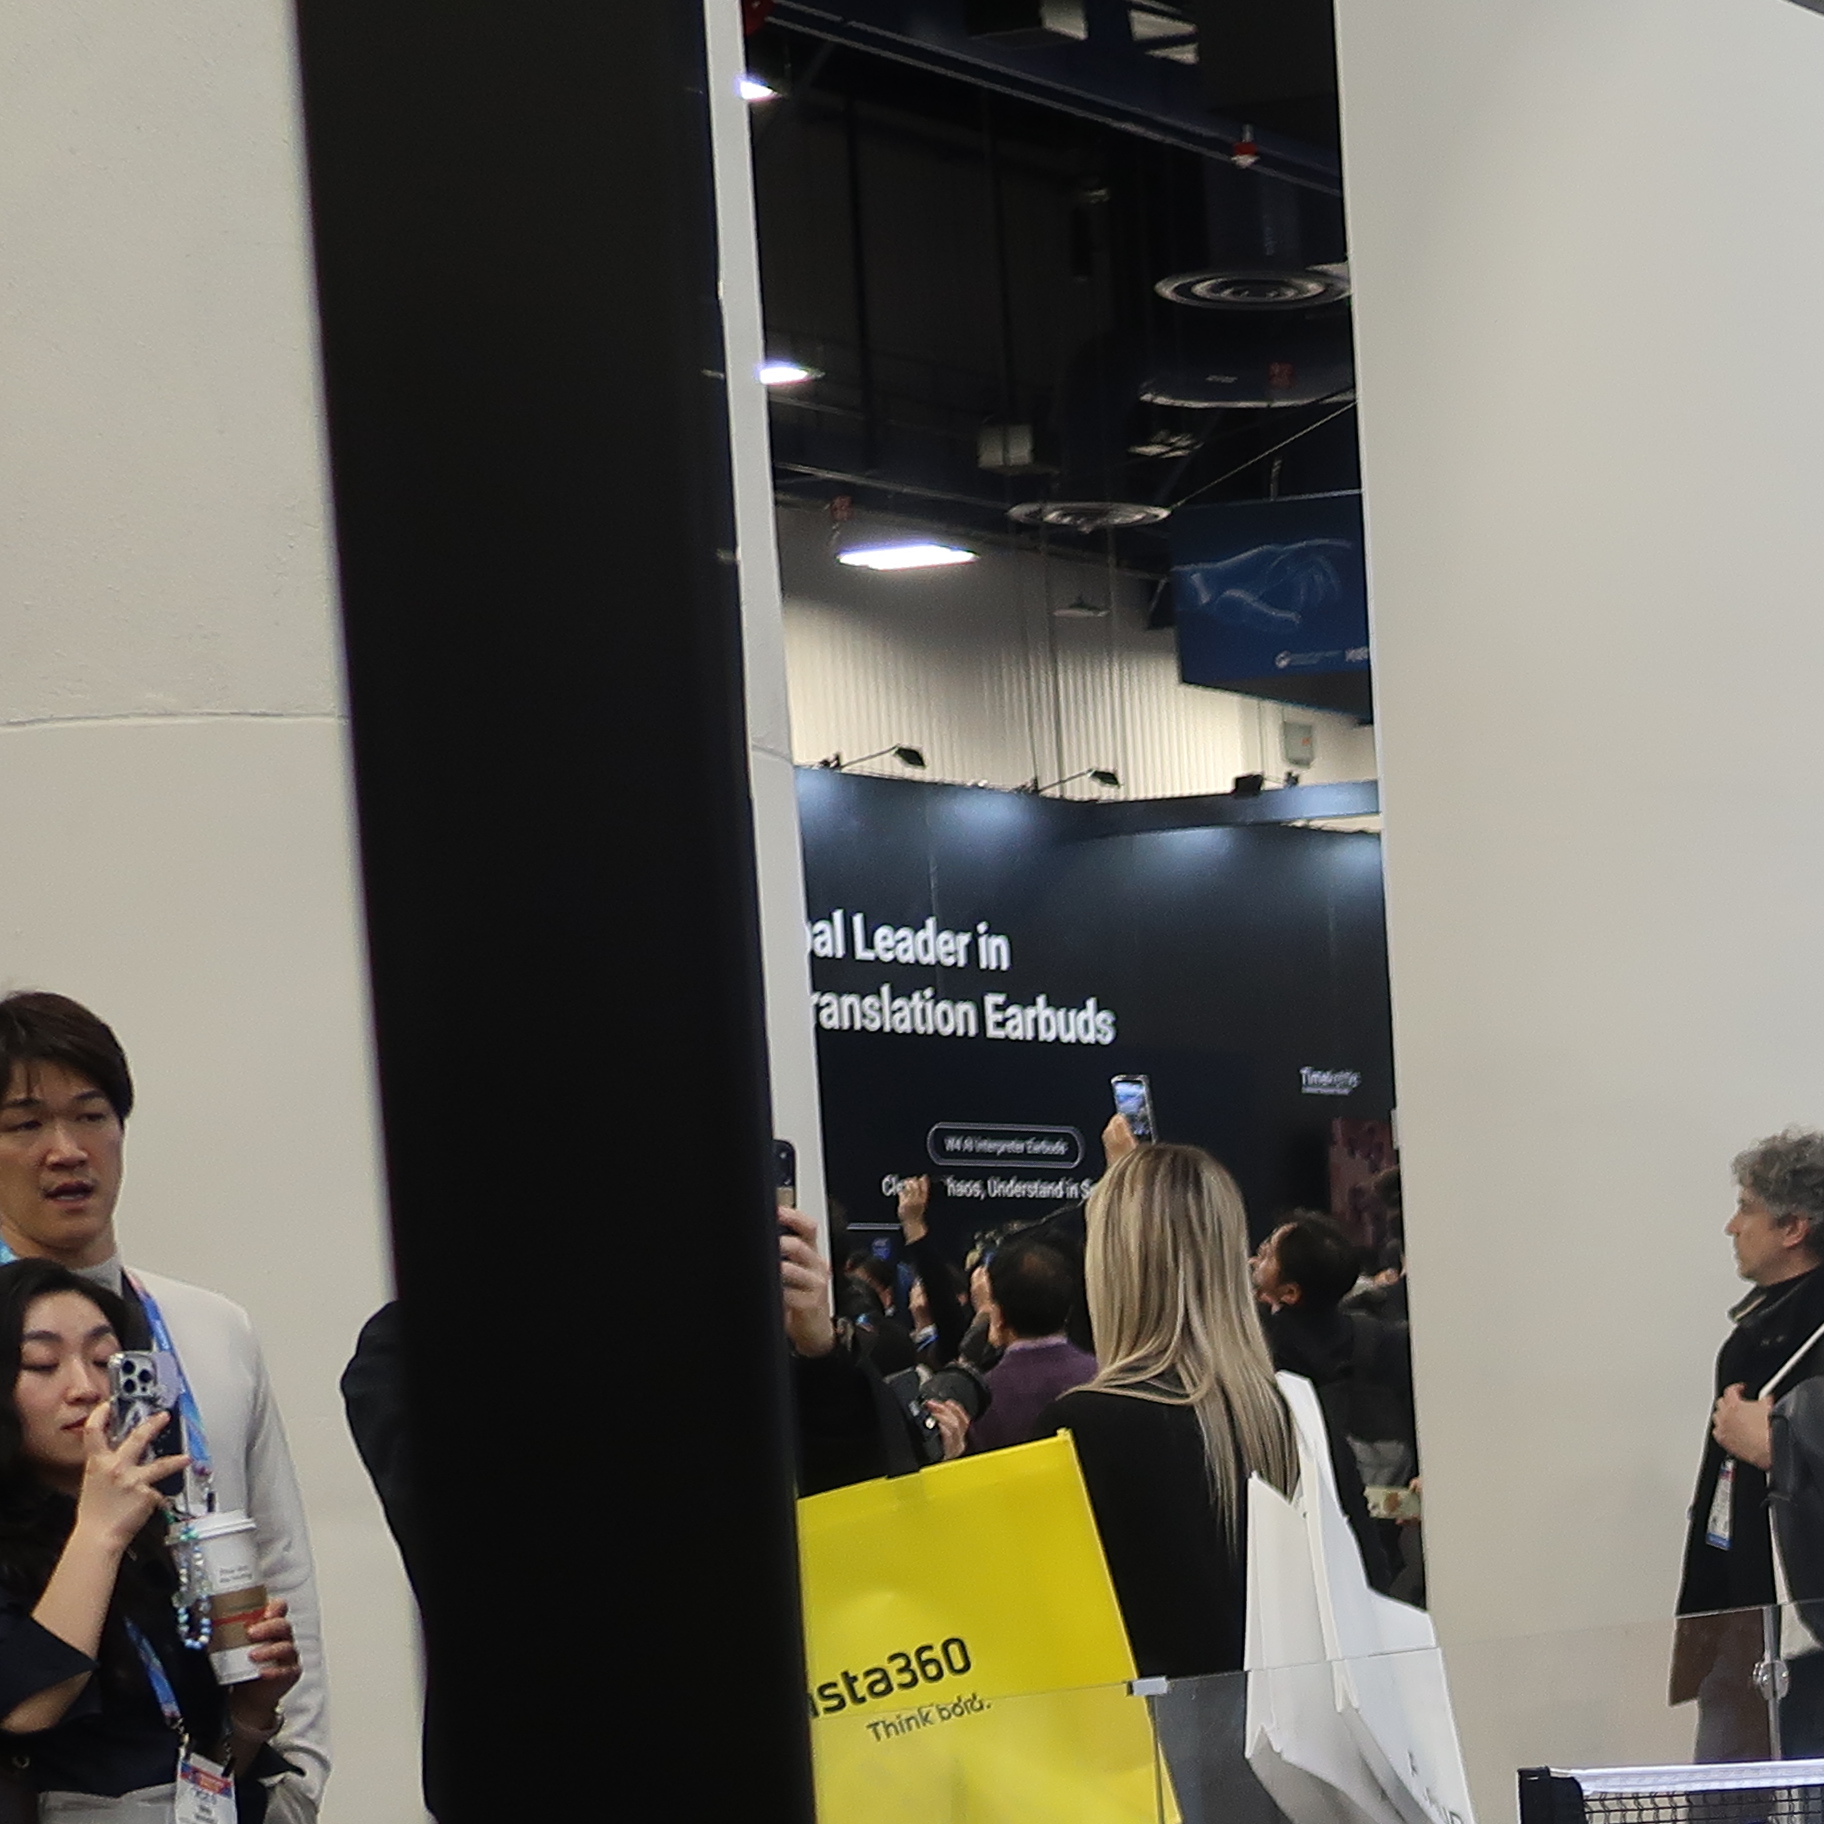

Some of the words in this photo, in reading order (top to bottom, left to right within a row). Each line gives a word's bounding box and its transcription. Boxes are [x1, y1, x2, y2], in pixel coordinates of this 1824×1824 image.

[806, 908, 846, 960] al
[852, 912, 972, 969] Leader
[976, 920, 1013, 971] in
[984, 993, 1118, 1045] Earbuds
[987, 1176, 1064, 1200] Understand
[865, 1706, 935, 1743] Think
